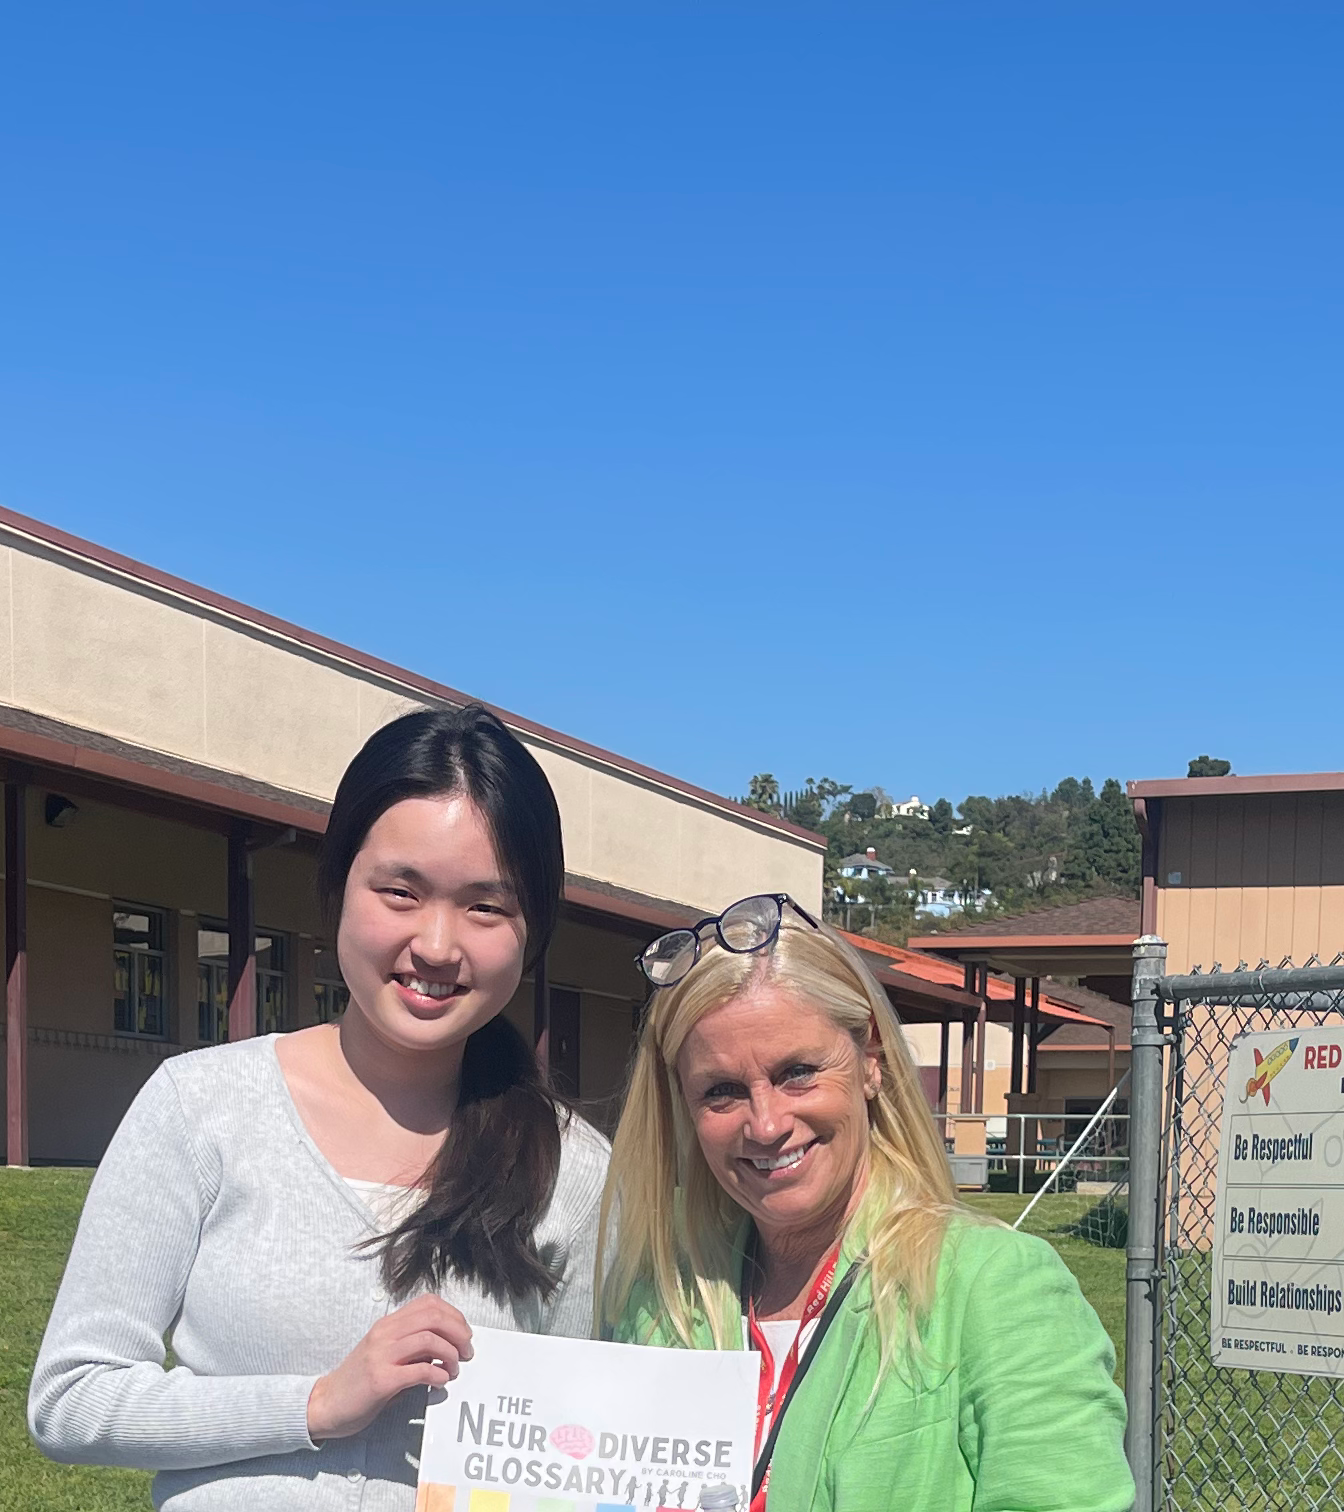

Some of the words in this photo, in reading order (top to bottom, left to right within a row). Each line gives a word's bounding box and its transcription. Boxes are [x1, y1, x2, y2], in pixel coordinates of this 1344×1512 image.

[1304, 1044, 1342, 1070] RED
[1234, 1133, 1249, 1161] Be
[1251, 1132, 1313, 1164] Respectful
[1230, 1206, 1245, 1234] Be
[1247, 1206, 1320, 1238] Responsible
[806, 1289, 825, 1315] Red
[1227, 1279, 1257, 1306] Build
[1260, 1280, 1342, 1315] Relationships
[1221, 1337, 1232, 1349] BE
[1234, 1338, 1287, 1354] RESPECTFUL
[1297, 1344, 1309, 1356] BE
[497, 1395, 533, 1416] THE
[598, 1431, 733, 1468] DIVERSE
[464, 1452, 627, 1496] GLOSSARY
[641, 1467, 654, 1475] BY
[656, 1468, 704, 1480] CAROLINE
[706, 1471, 727, 1480] CHO
